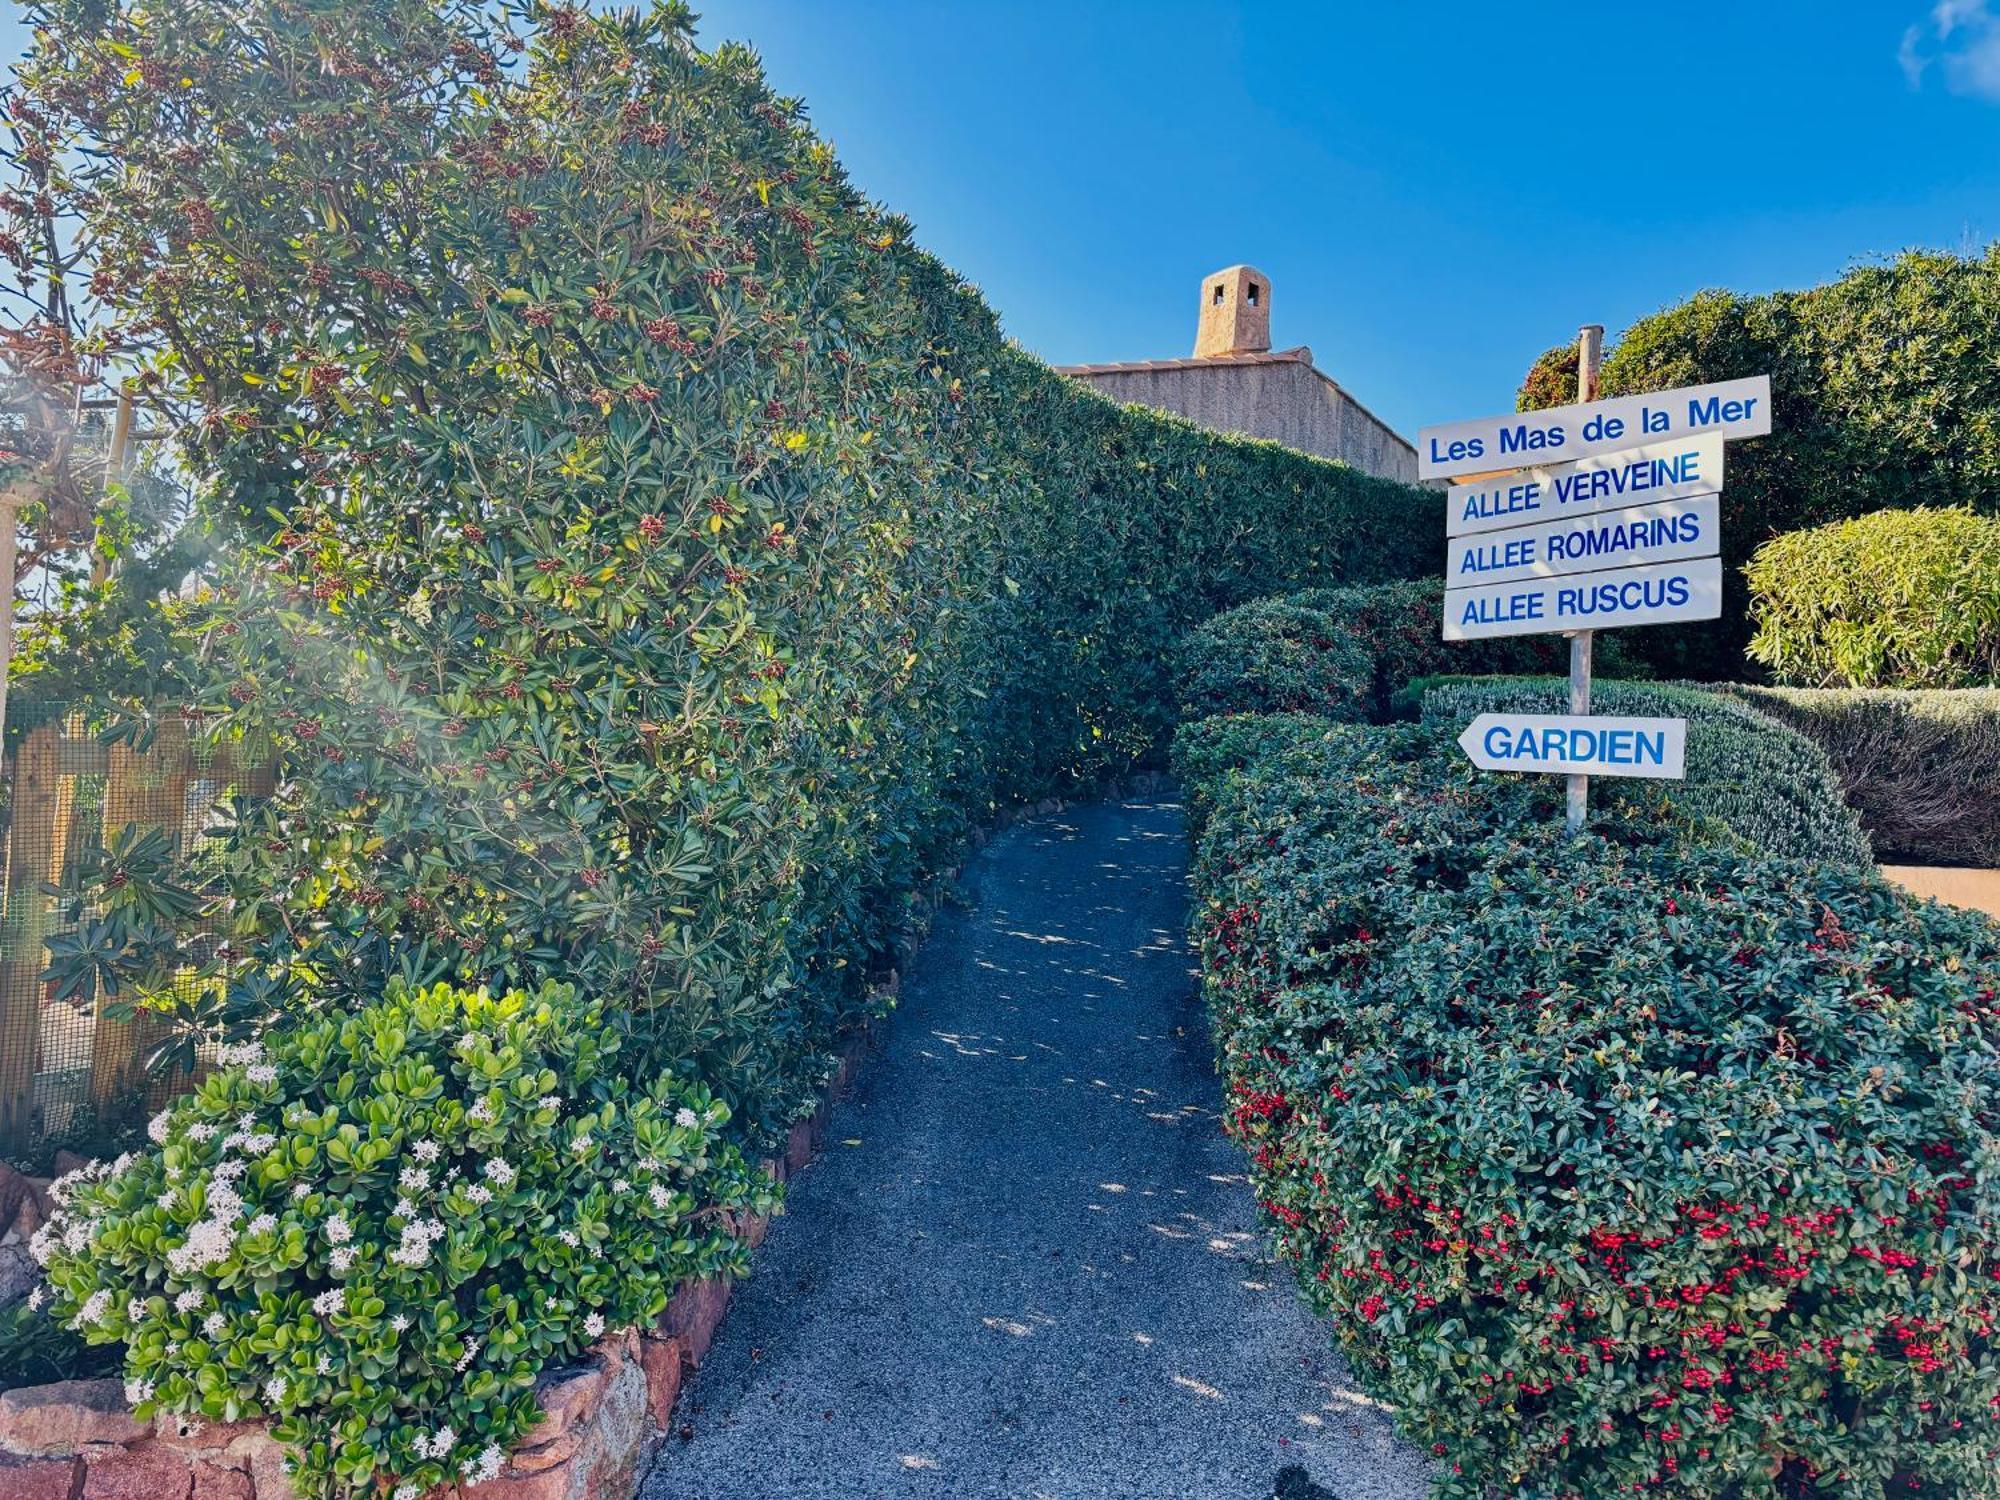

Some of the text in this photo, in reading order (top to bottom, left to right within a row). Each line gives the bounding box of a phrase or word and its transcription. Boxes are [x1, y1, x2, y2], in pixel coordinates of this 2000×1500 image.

[1430, 396, 1758, 464] Les Mas de la Mer
[1462, 451, 1701, 521] ALLEE VERVEINE
[1460, 512, 1700, 574] ALLEE ROMARINS
[1461, 576, 1690, 625] ALLEE RUSCUS
[1483, 726, 1665, 765] GARDIEN
